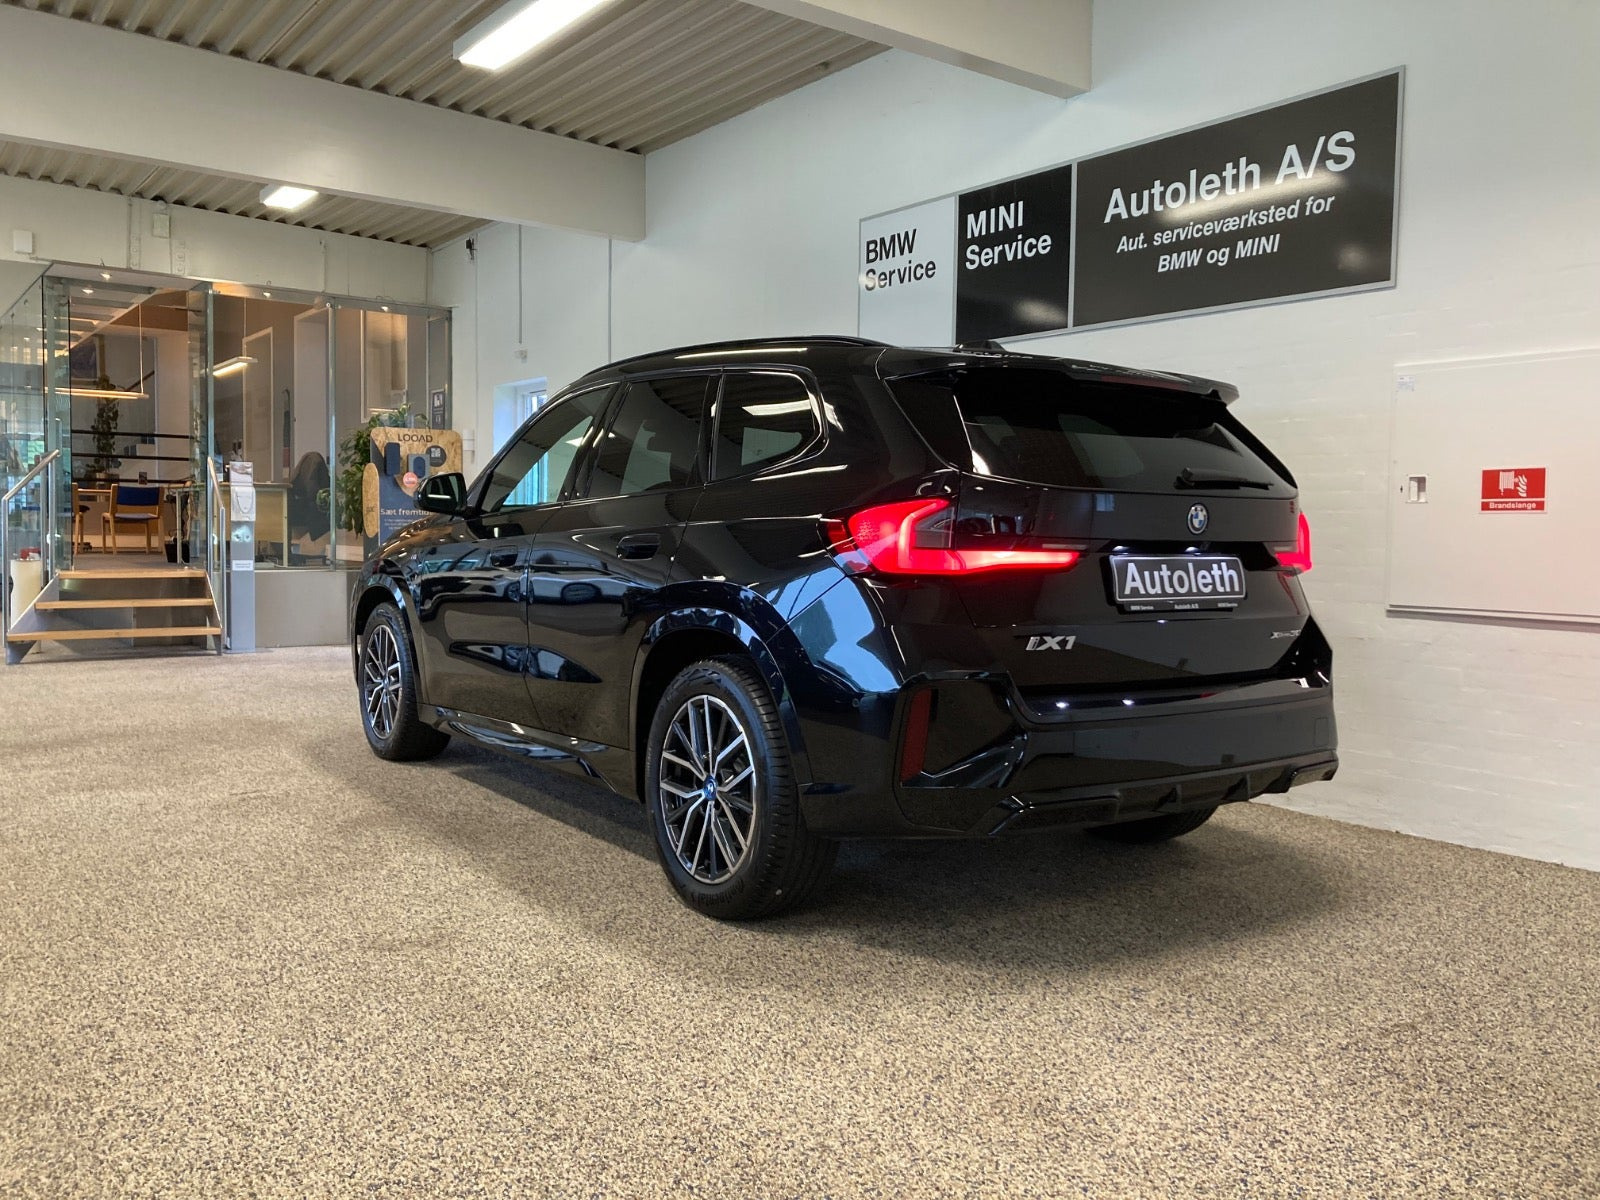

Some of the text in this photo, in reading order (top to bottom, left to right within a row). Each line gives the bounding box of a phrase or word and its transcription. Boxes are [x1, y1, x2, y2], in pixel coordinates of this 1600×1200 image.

[1104, 130, 1356, 223] Autoleth A/S
[966, 200, 1024, 239] MINI
[1116, 195, 1335, 253] Aut. serviceværksted for
[866, 228, 917, 264] BMW
[965, 233, 1052, 270] Service
[1157, 233, 1280, 273] BMW og MINI
[865, 259, 936, 292] Service
[397, 433, 433, 443] LOOAD
[1489, 501, 1536, 510] Brandslange
[1124, 562, 1240, 594] Autoleth
[1025, 635, 1077, 651] iX1
